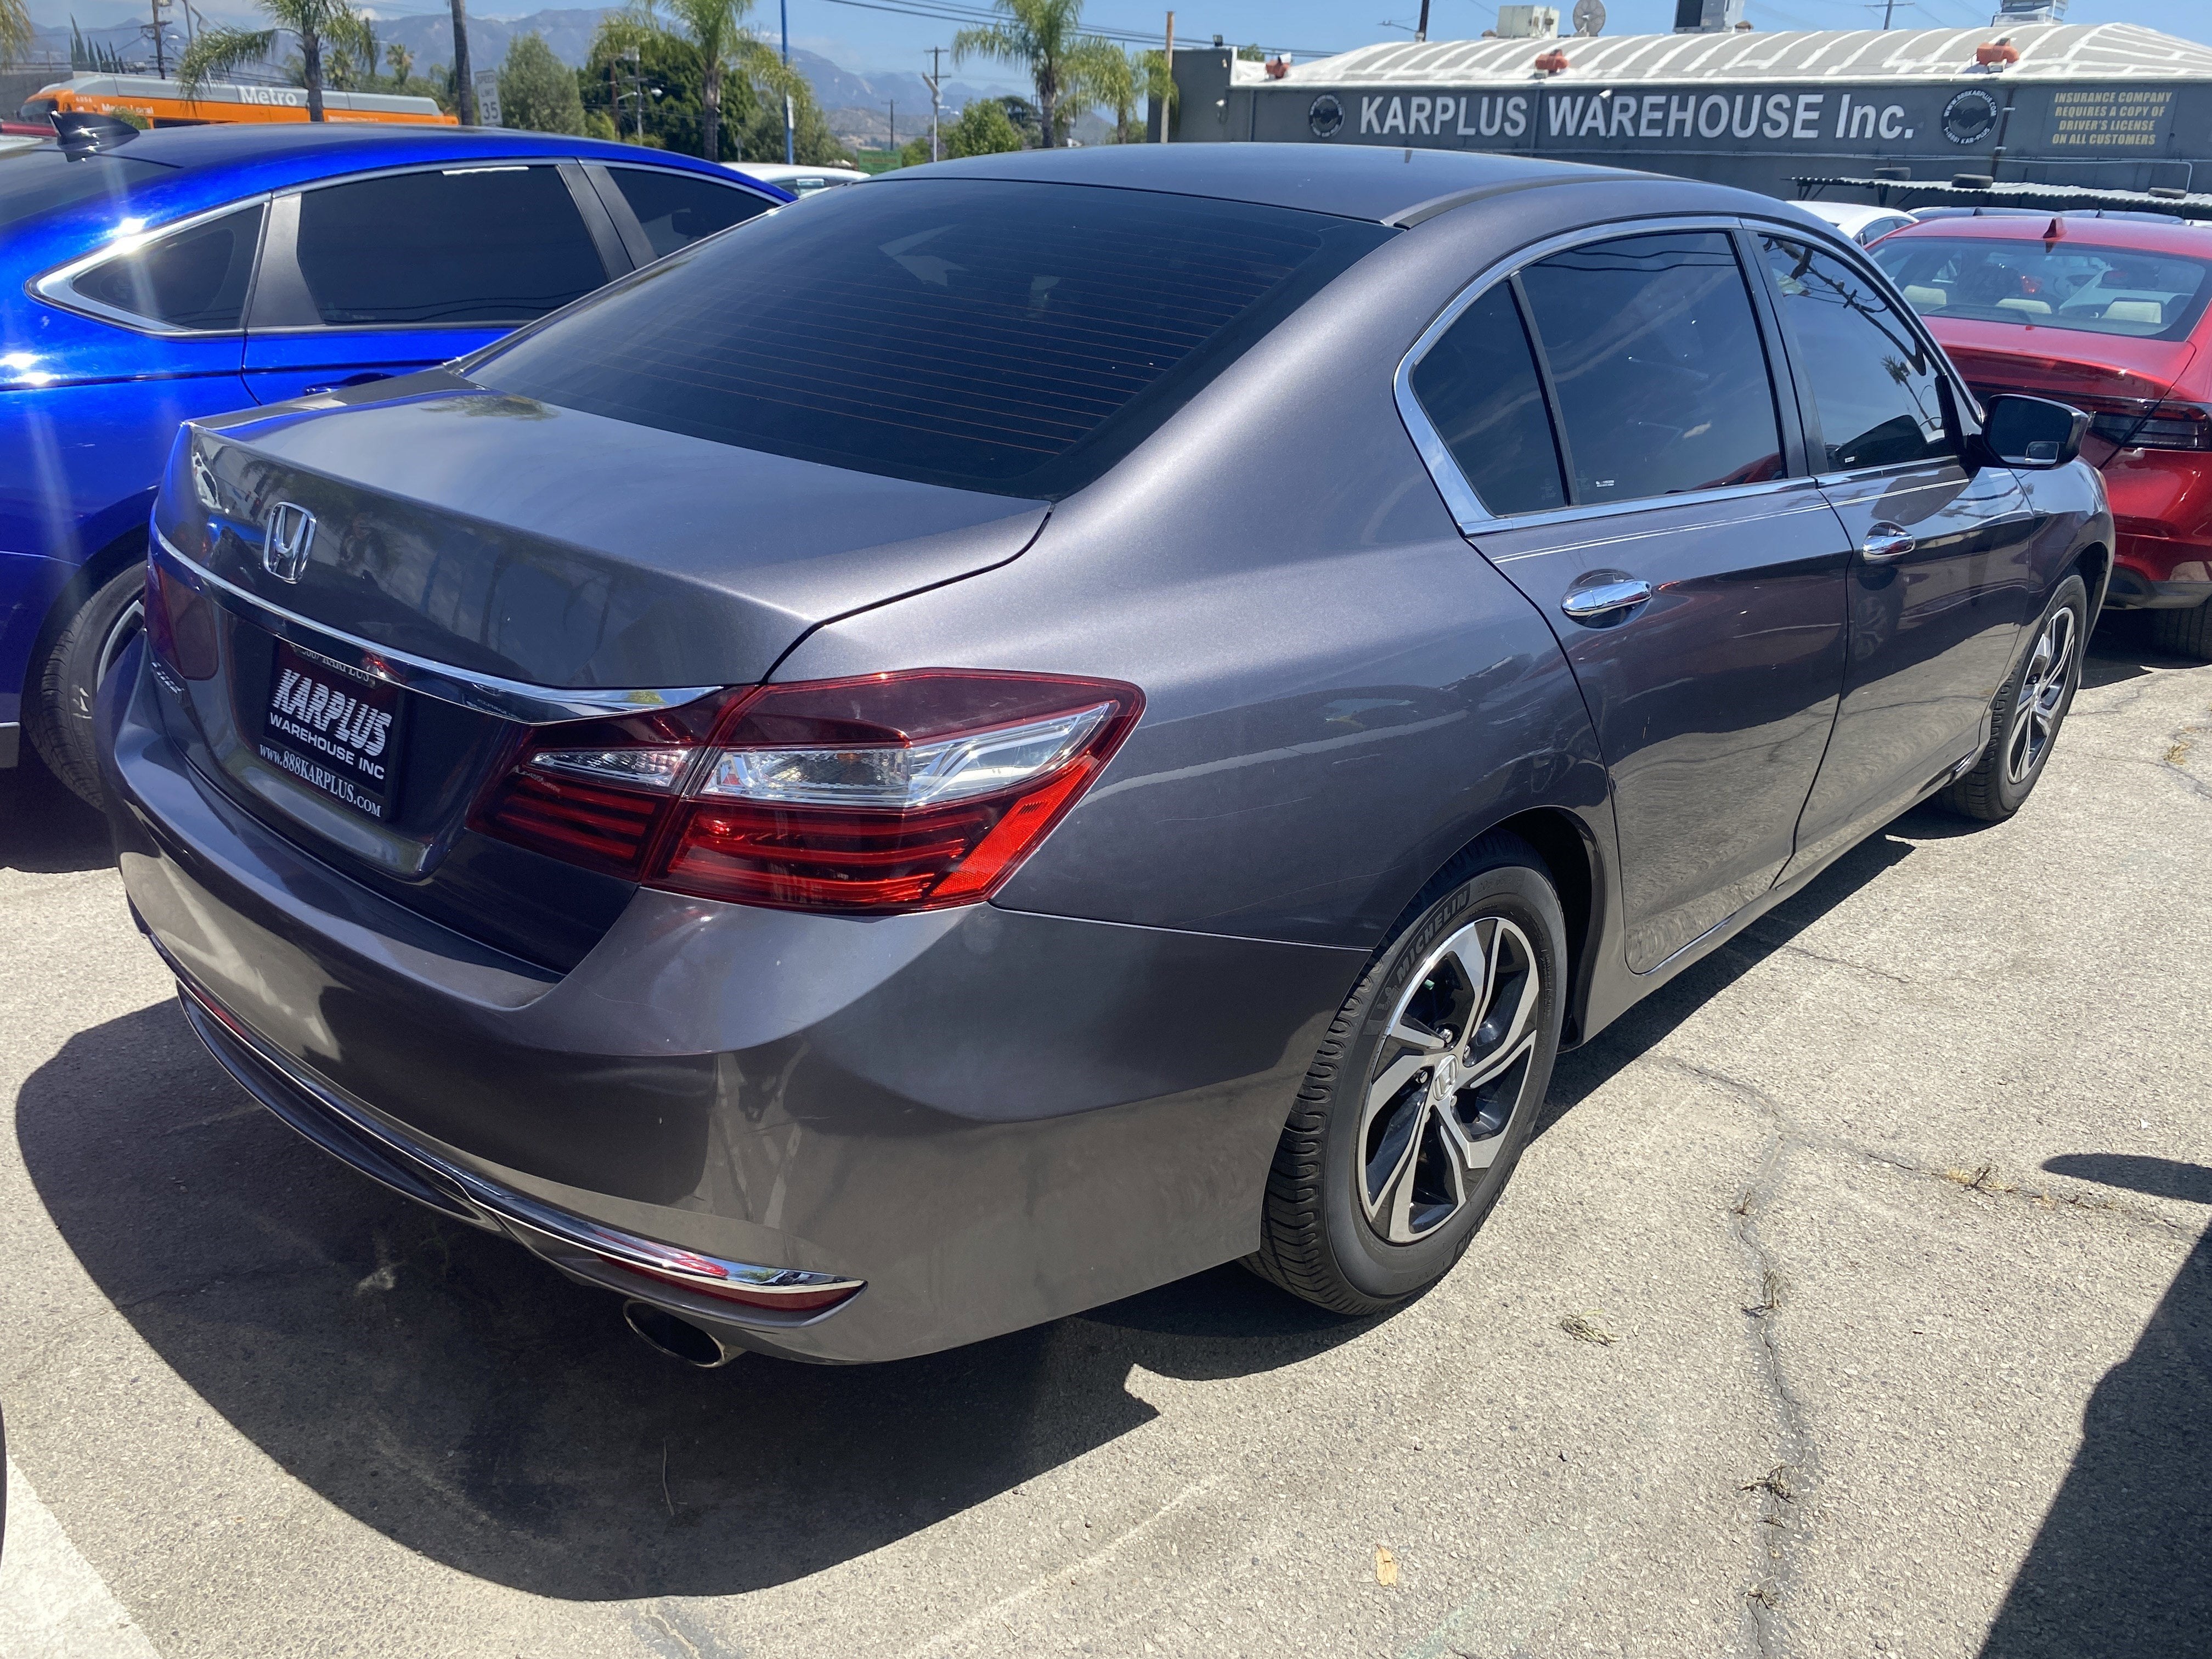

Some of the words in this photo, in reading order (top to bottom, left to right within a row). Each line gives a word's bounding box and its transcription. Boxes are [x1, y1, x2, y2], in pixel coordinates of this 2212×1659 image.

[240, 86, 297, 106] Metro
[2055, 92, 2116, 103] INSURANCE
[2118, 92, 2172, 103] COMPANY
[482, 101, 499, 120] 35
[1360, 96, 1528, 137] KARPLUS
[1548, 94, 1824, 139] WAREHOUSE
[1835, 94, 1915, 139] Inc.
[2055, 106, 2107, 117] REQUIRES
[2109, 106, 2117, 117] A
[2119, 106, 2149, 117] COPY
[2151, 106, 2165, 116] OF
[2059, 120, 2108, 131] DRIVER'S
[2111, 120, 2155, 131] LICENSE
[2052, 134, 2068, 144] ON
[2069, 134, 2086, 144] ALL
[2089, 134, 2157, 145] CUSTOMERS
[272, 668, 393, 757] KARPLUS
[269, 712, 355, 765] WAREHOUSE
[358, 757, 385, 780] INC
[1396, 890, 1469, 982] MICHELIN
